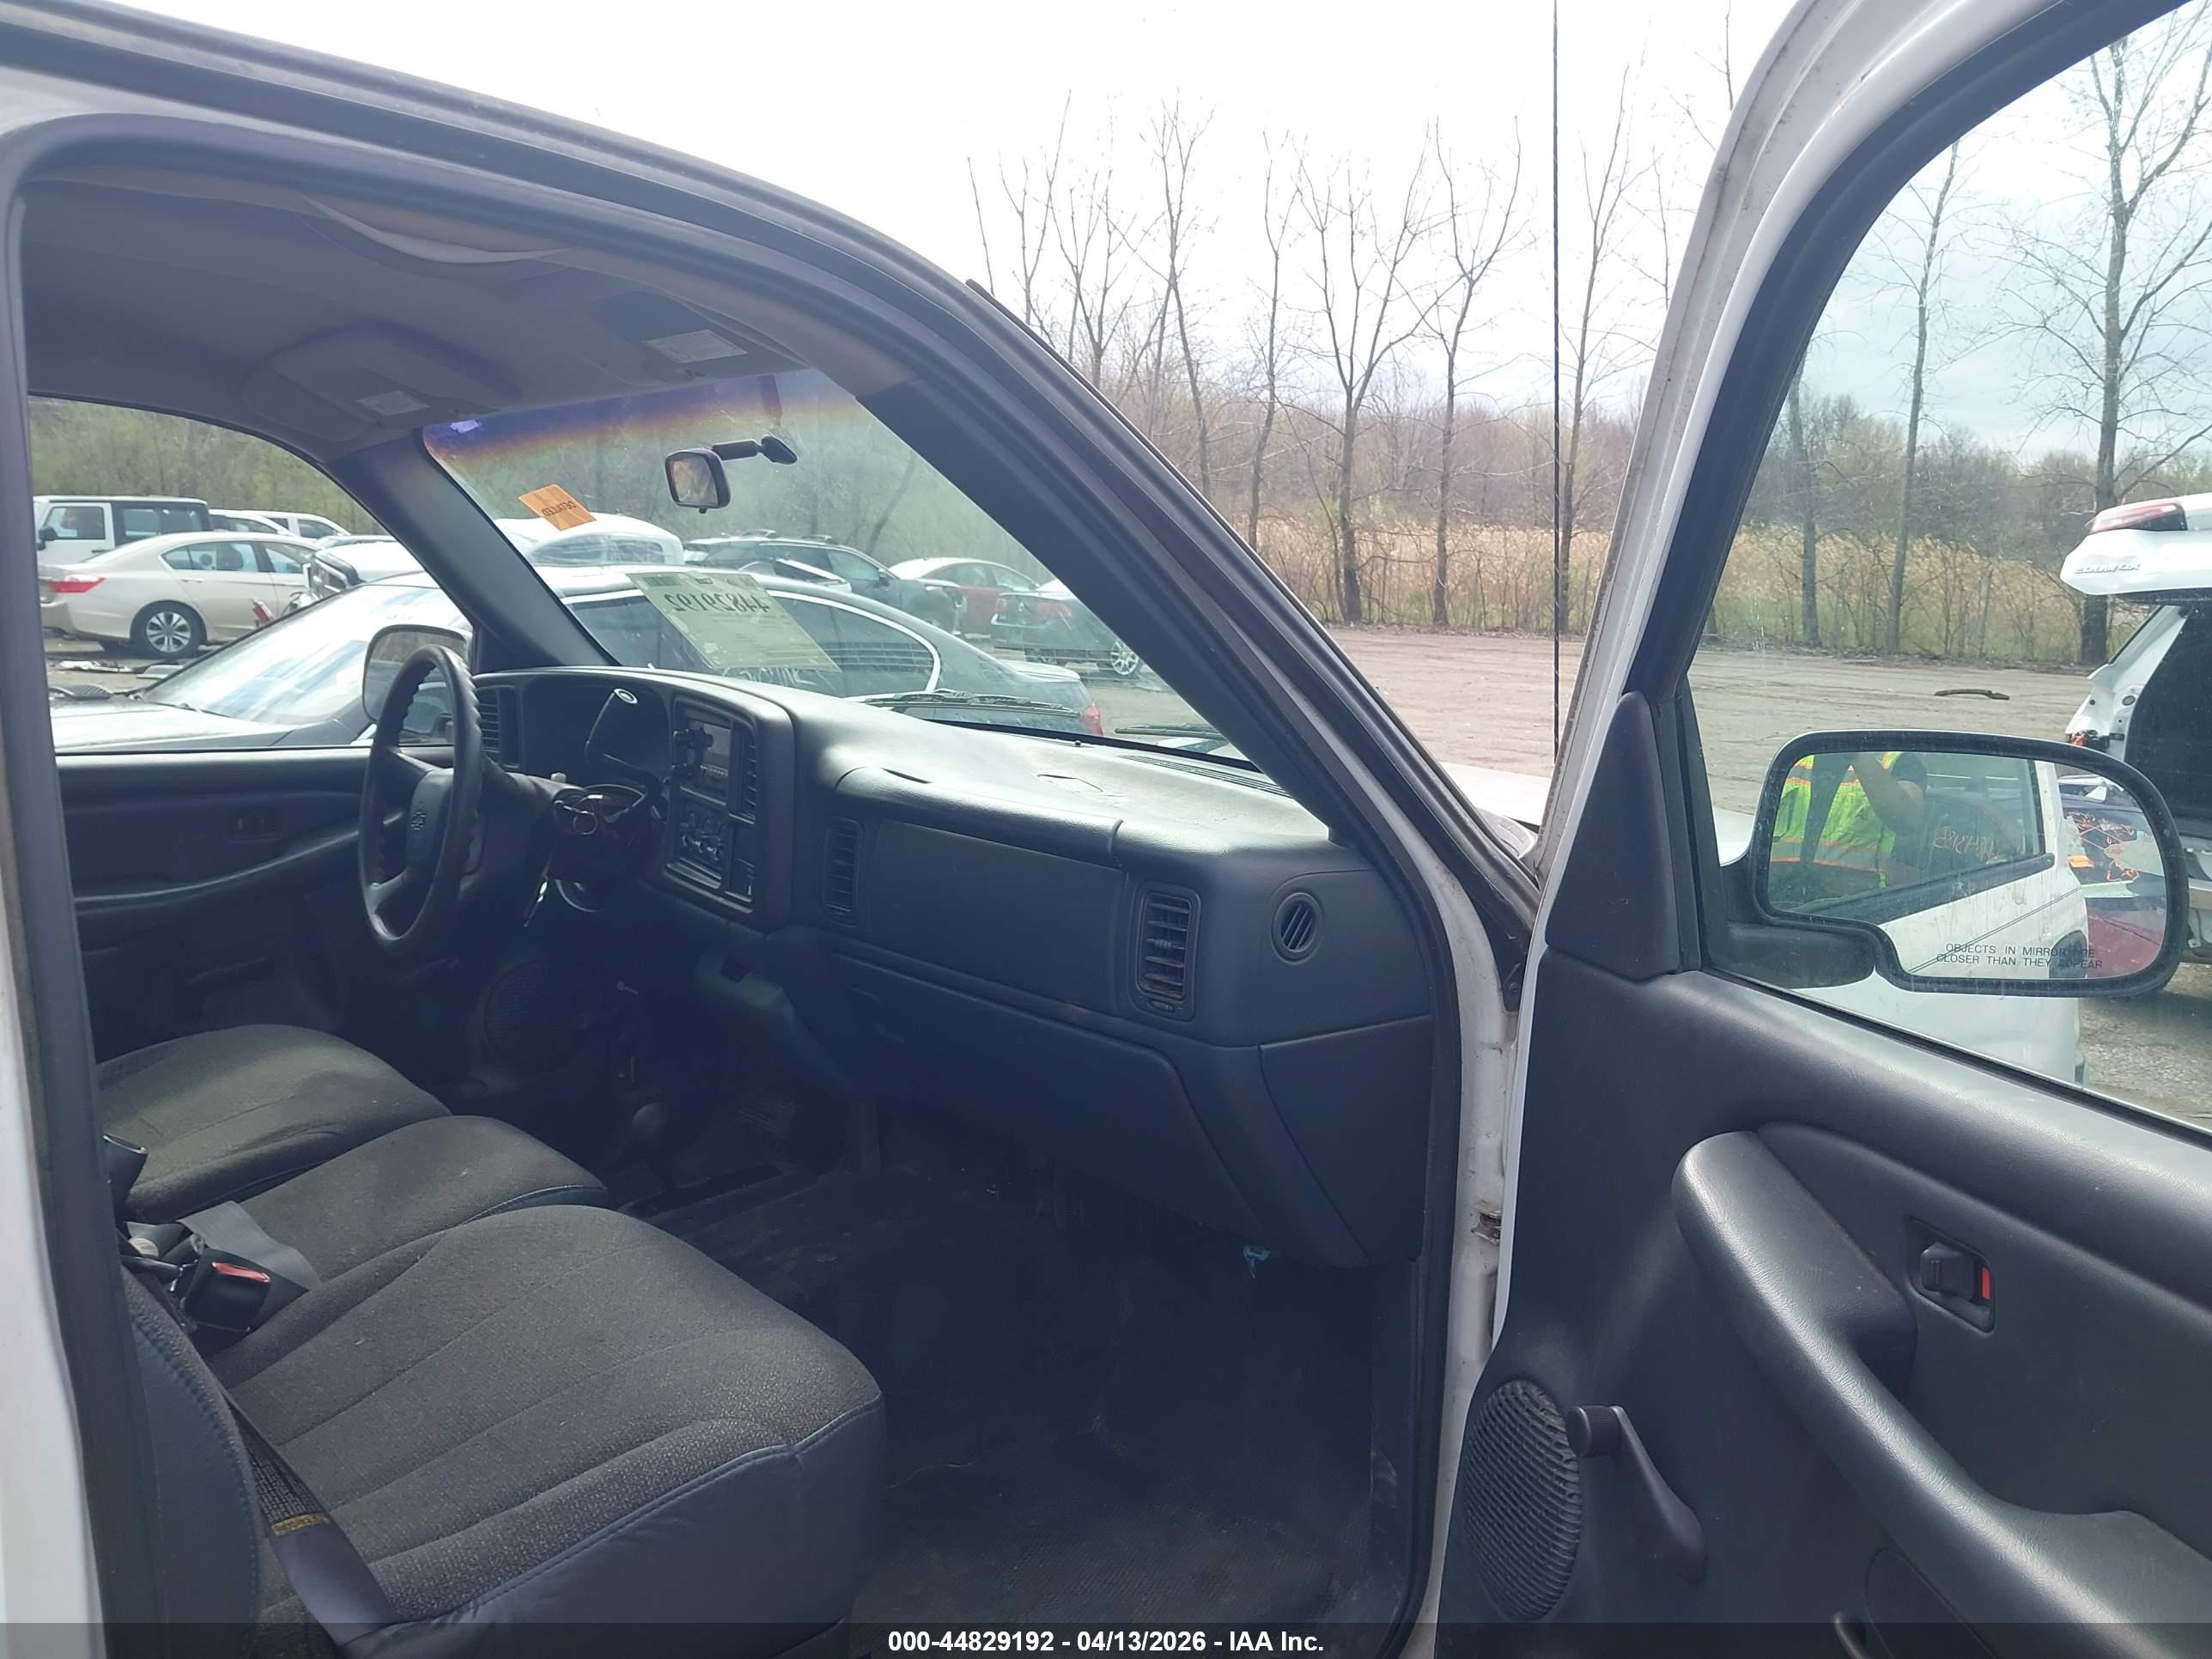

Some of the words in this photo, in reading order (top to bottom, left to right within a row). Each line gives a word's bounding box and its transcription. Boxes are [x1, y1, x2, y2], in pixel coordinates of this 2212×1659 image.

[1945, 943, 1996, 955] OBJECTS
[2004, 945, 2016, 955] IN
[2022, 946, 2067, 957] MIRROR
[1936, 953, 1980, 964] CLOSER
[1987, 956, 2017, 966] THAN
[2023, 957, 2051, 968] THEY
